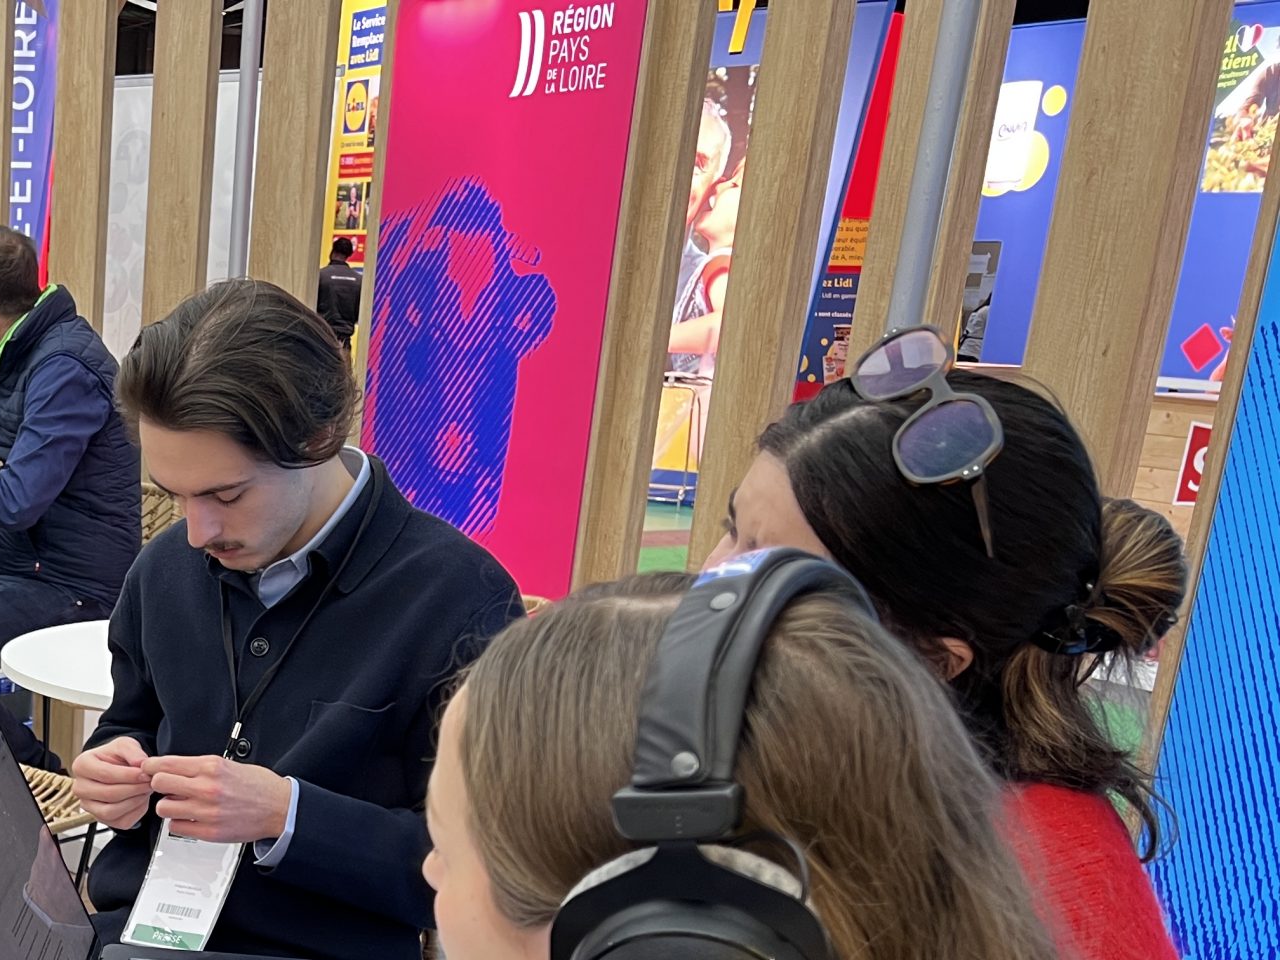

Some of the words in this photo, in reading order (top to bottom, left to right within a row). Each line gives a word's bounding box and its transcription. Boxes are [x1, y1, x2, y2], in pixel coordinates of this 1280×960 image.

[552, 2, 615, 35] RÉGION
[548, 35, 590, 65] PAYS
[546, 68, 558, 81] DE
[559, 62, 608, 93] LOIRE
[545, 82, 556, 94] LA
[834, 278, 852, 288] Lidl
